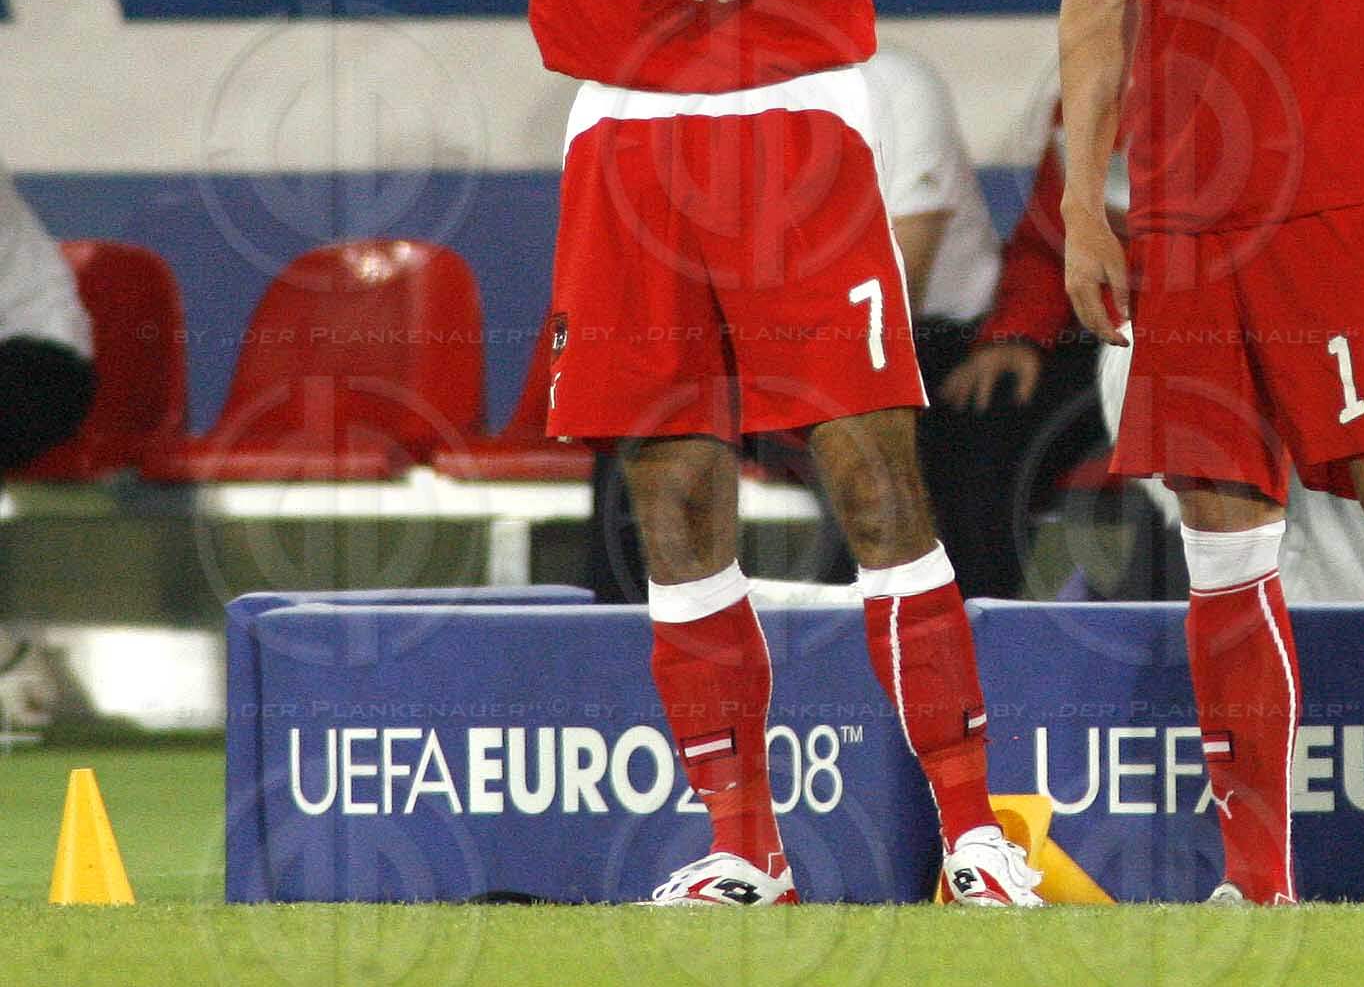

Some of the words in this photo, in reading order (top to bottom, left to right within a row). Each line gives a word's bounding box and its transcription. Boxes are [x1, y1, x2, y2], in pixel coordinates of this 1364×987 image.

[848, 277, 886, 371] 7
[288, 726, 463, 816] UEFA
[467, 724, 675, 816] EURO
